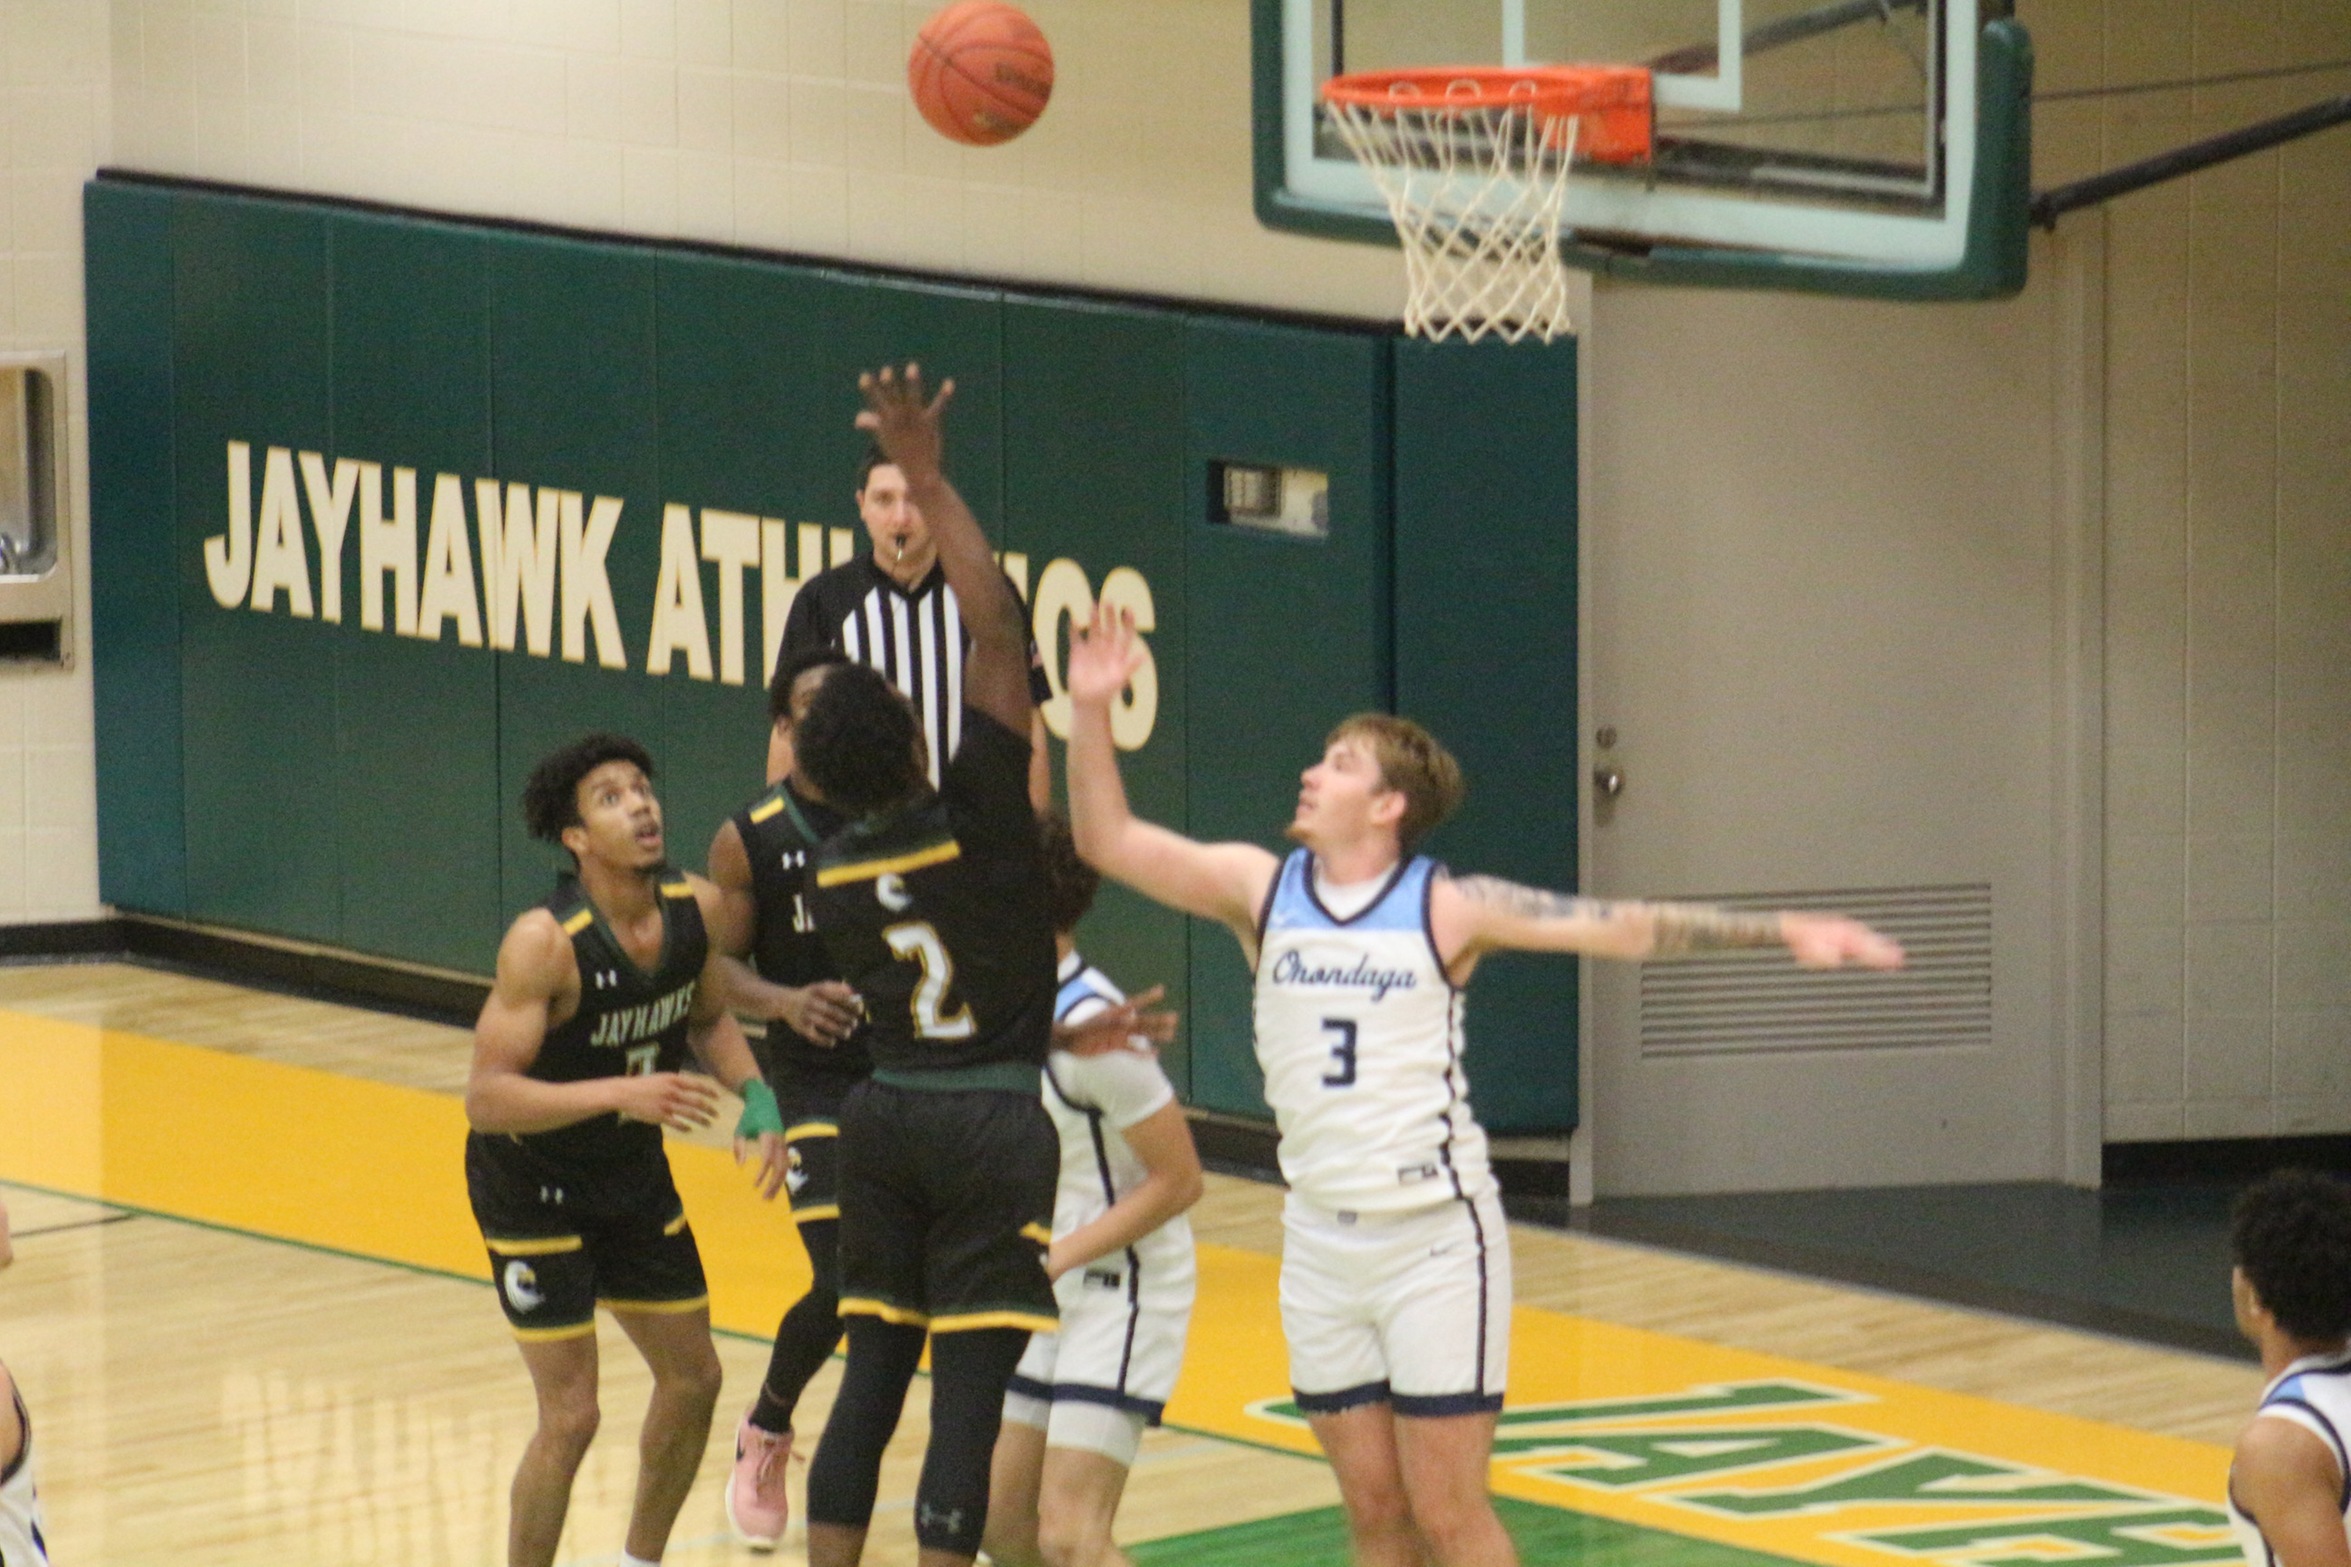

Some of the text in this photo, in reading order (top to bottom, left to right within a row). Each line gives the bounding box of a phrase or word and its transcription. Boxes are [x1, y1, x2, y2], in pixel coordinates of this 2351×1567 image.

[203, 439, 628, 670] JAYHAWK
[880, 920, 979, 1040] 2
[1320, 1017, 1358, 1087] 3
